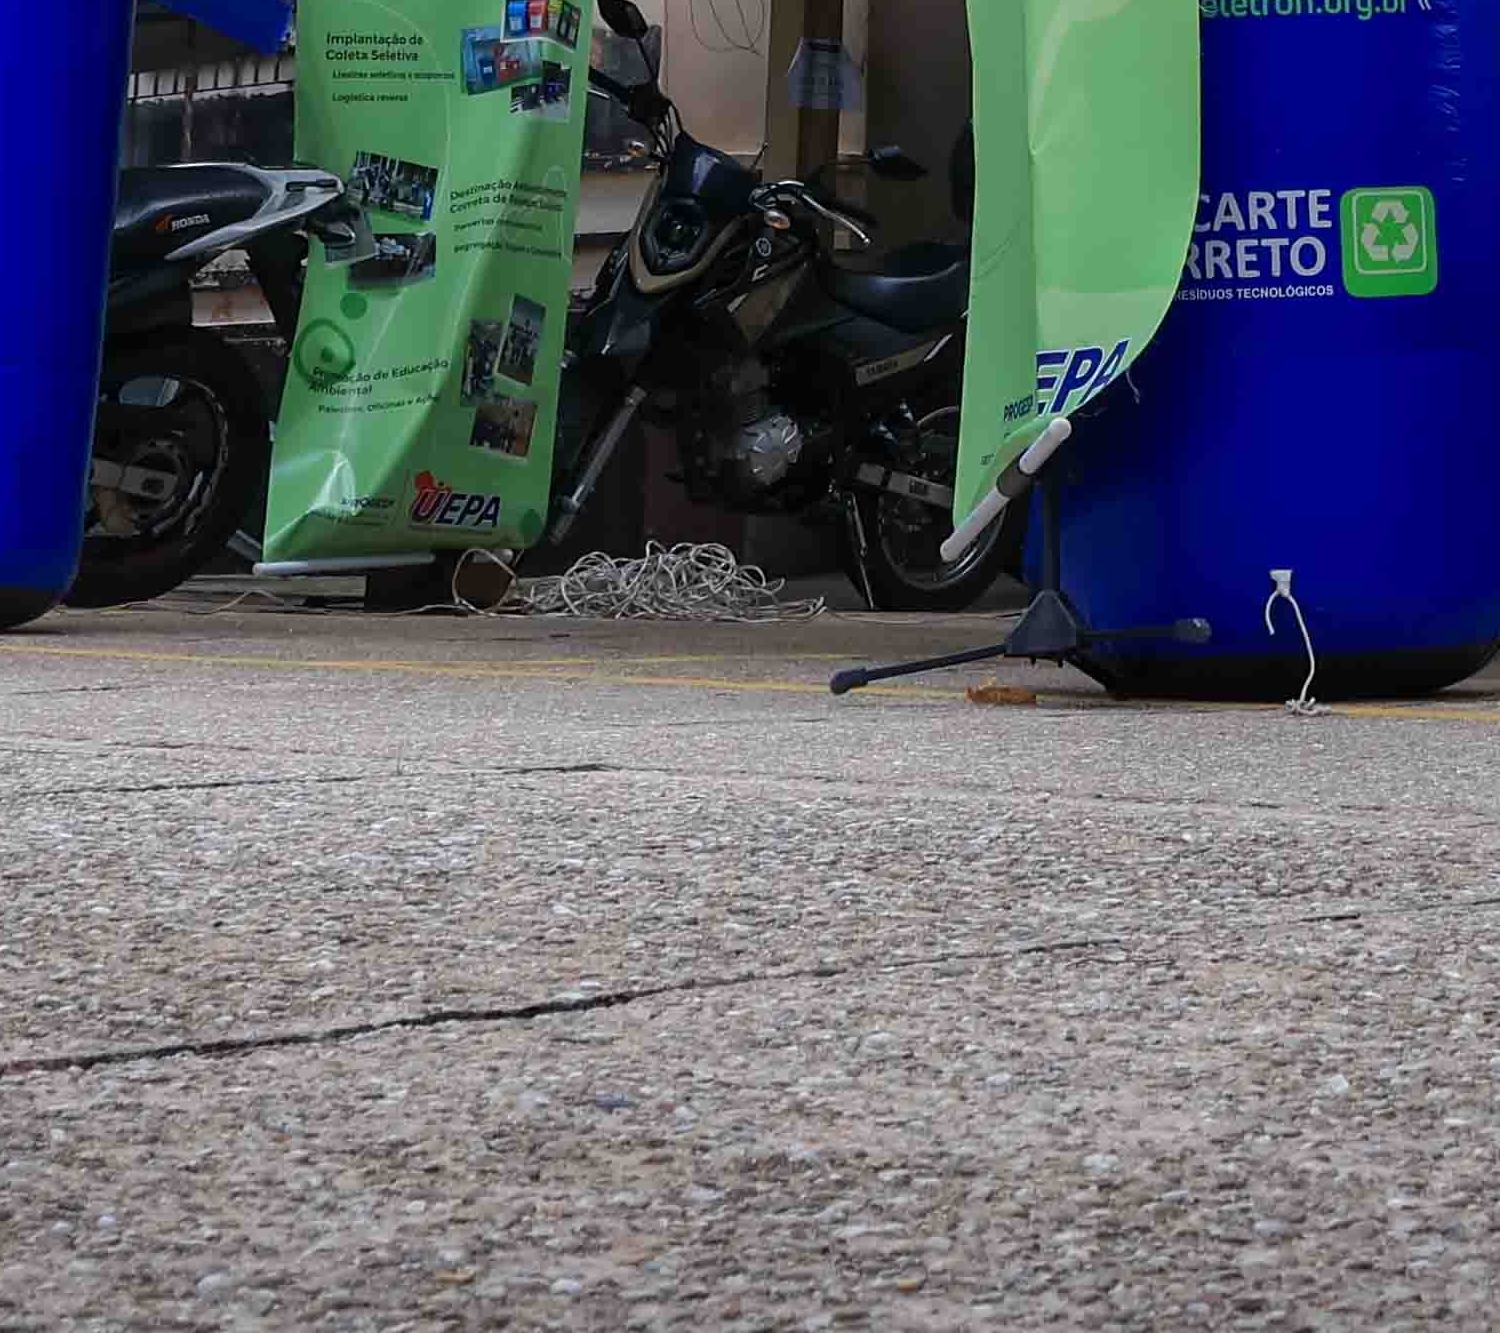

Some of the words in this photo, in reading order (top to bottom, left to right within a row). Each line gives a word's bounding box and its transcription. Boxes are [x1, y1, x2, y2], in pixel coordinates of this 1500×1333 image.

[325, 48, 369, 62] Coleta
[371, 47, 419, 62] Seletiva
[1236, 283, 1334, 300] TECNOLÓGICOS
